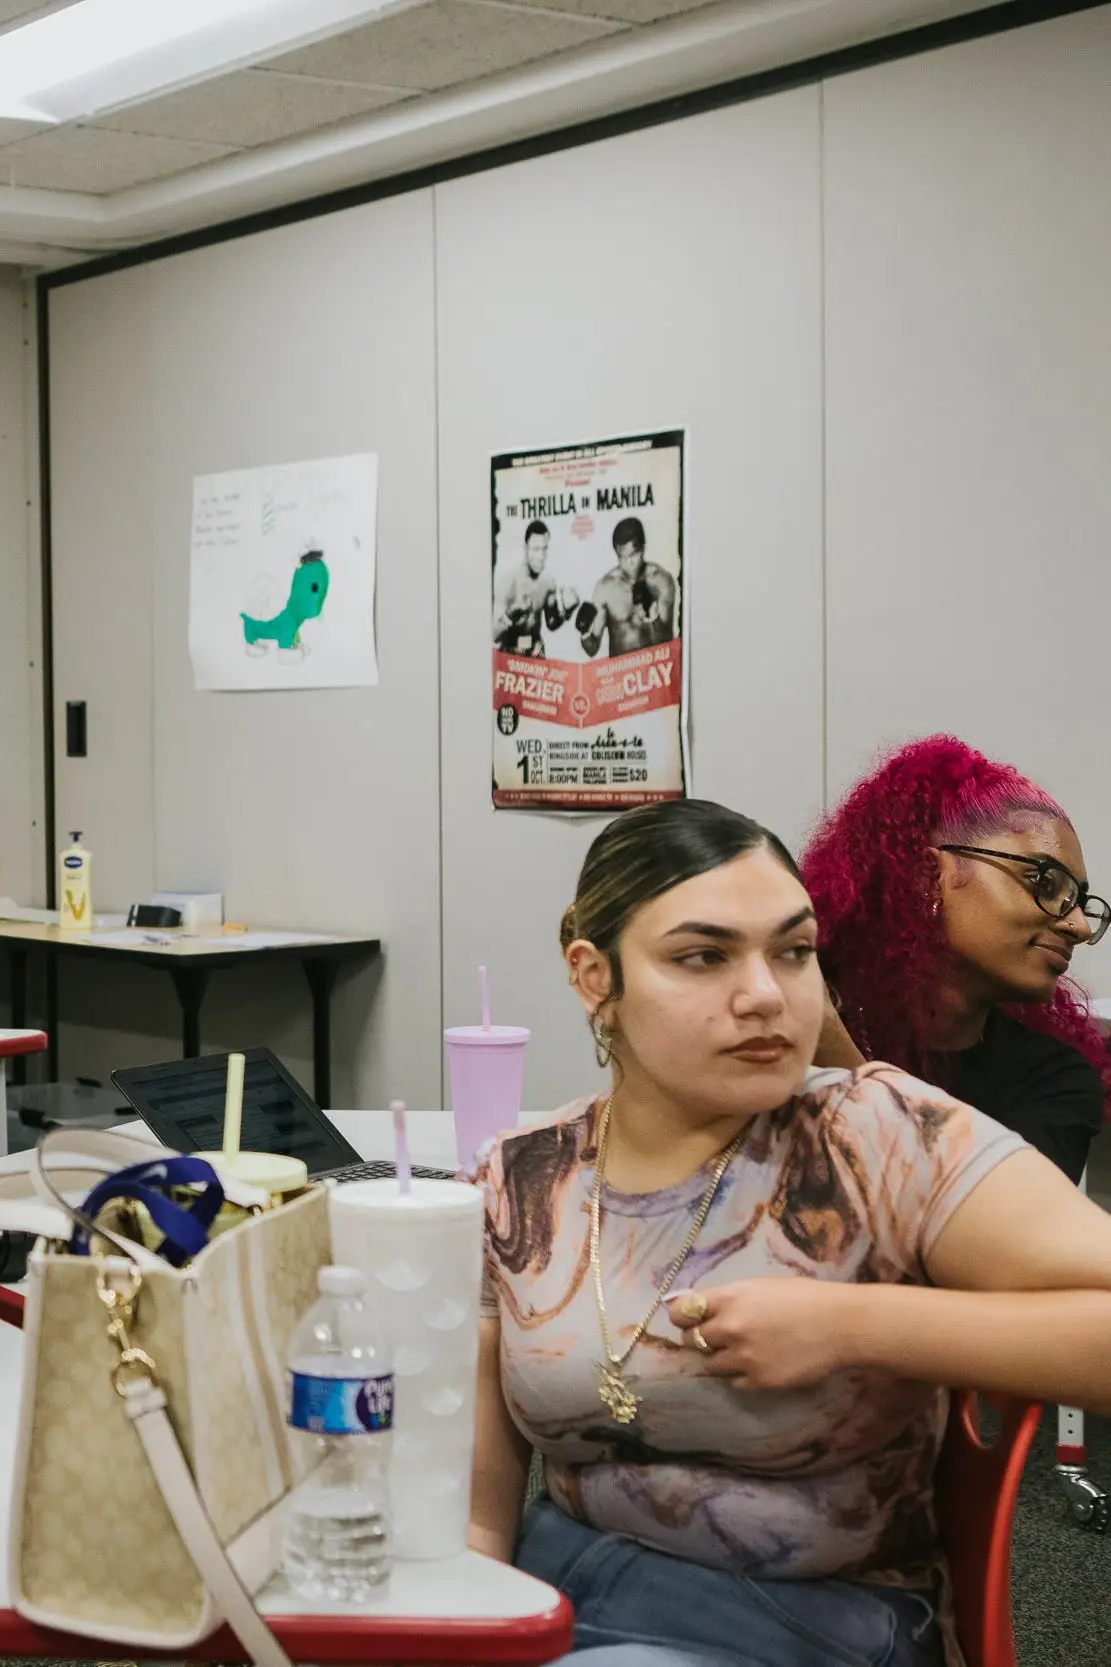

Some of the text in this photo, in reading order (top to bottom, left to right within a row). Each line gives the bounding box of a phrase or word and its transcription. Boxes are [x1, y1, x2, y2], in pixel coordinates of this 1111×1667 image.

[520, 492, 577, 519] THRILLA
[581, 497, 592, 509] IN
[596, 482, 655, 510] MANILA
[623, 661, 673, 696] CLAY
[494, 671, 565, 704] FRAZIER
[501, 707, 514, 716] NO
[501, 724, 514, 733] TV
[516, 739, 546, 753] WED.
[549, 752, 579, 760] RINGSIDE
[581, 752, 589, 760] AT
[517, 755, 544, 784] 1 ST
[629, 768, 648, 782] $20
